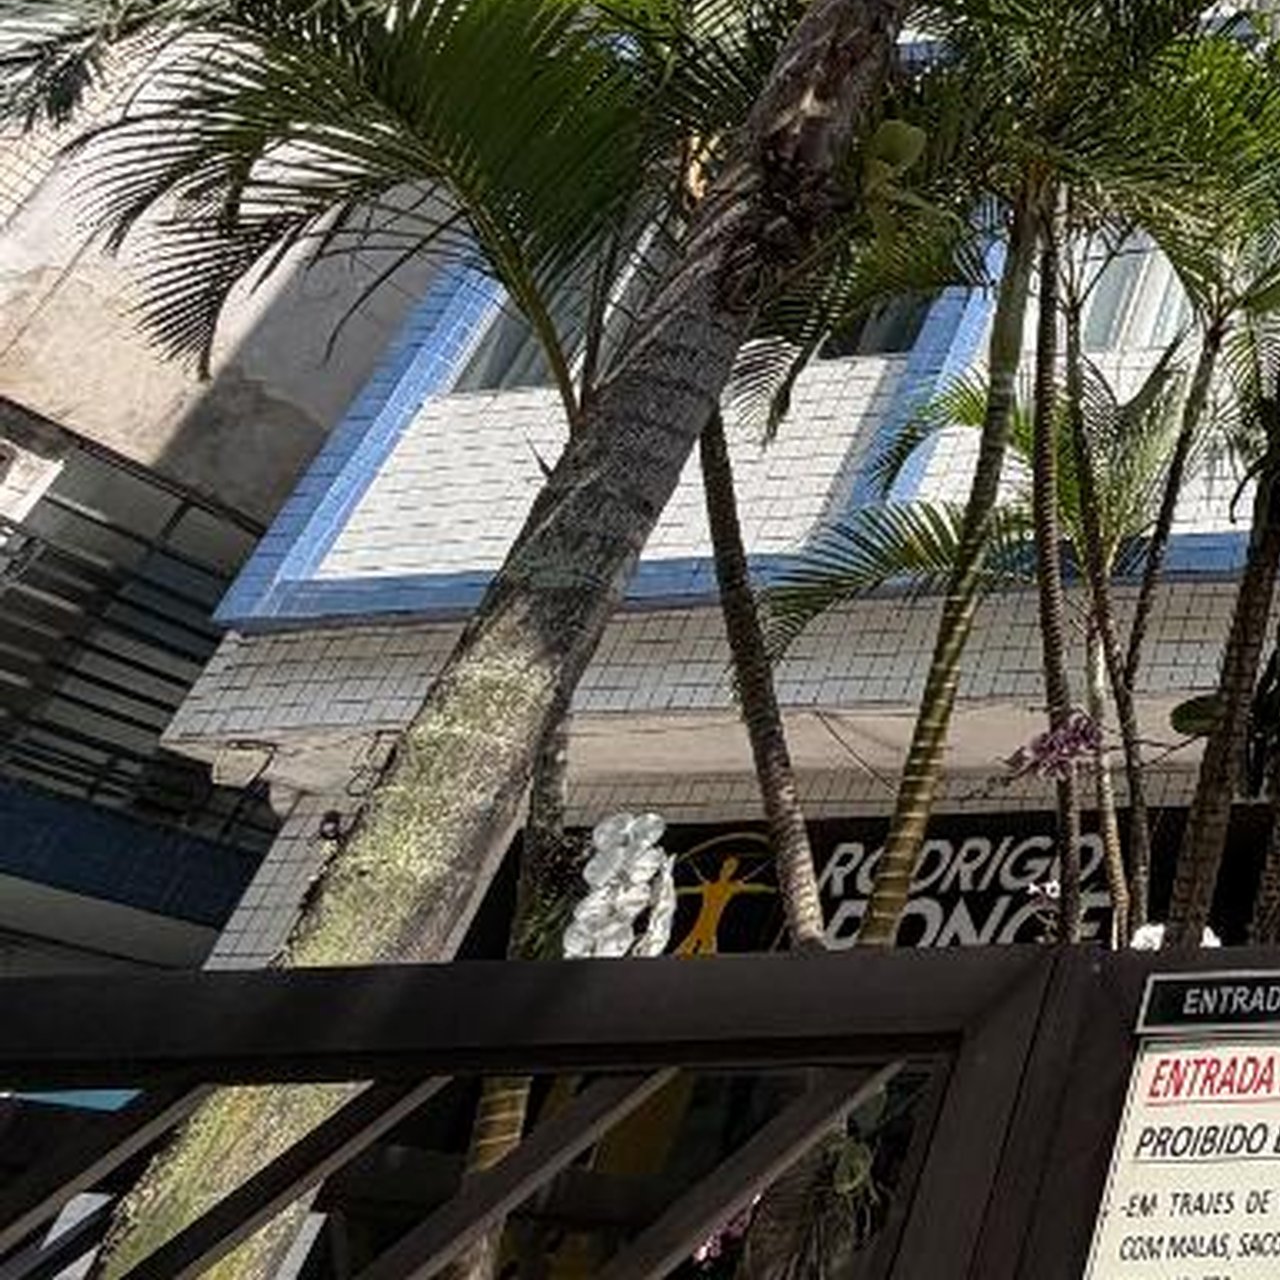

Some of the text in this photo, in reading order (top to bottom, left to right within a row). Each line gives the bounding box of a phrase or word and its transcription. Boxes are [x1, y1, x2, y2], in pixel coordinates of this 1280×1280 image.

[1149, 1056, 1275, 1098] ENTRADA
[1135, 1122, 1269, 1158] PROIBIDO
[1120, 1193, 1158, 1218] -EM
[1169, 1191, 1235, 1217] TRAJES
[1245, 1189, 1272, 1214] DE
[1119, 1235, 1164, 1261] COM
[1166, 1233, 1231, 1261] MALAS,
